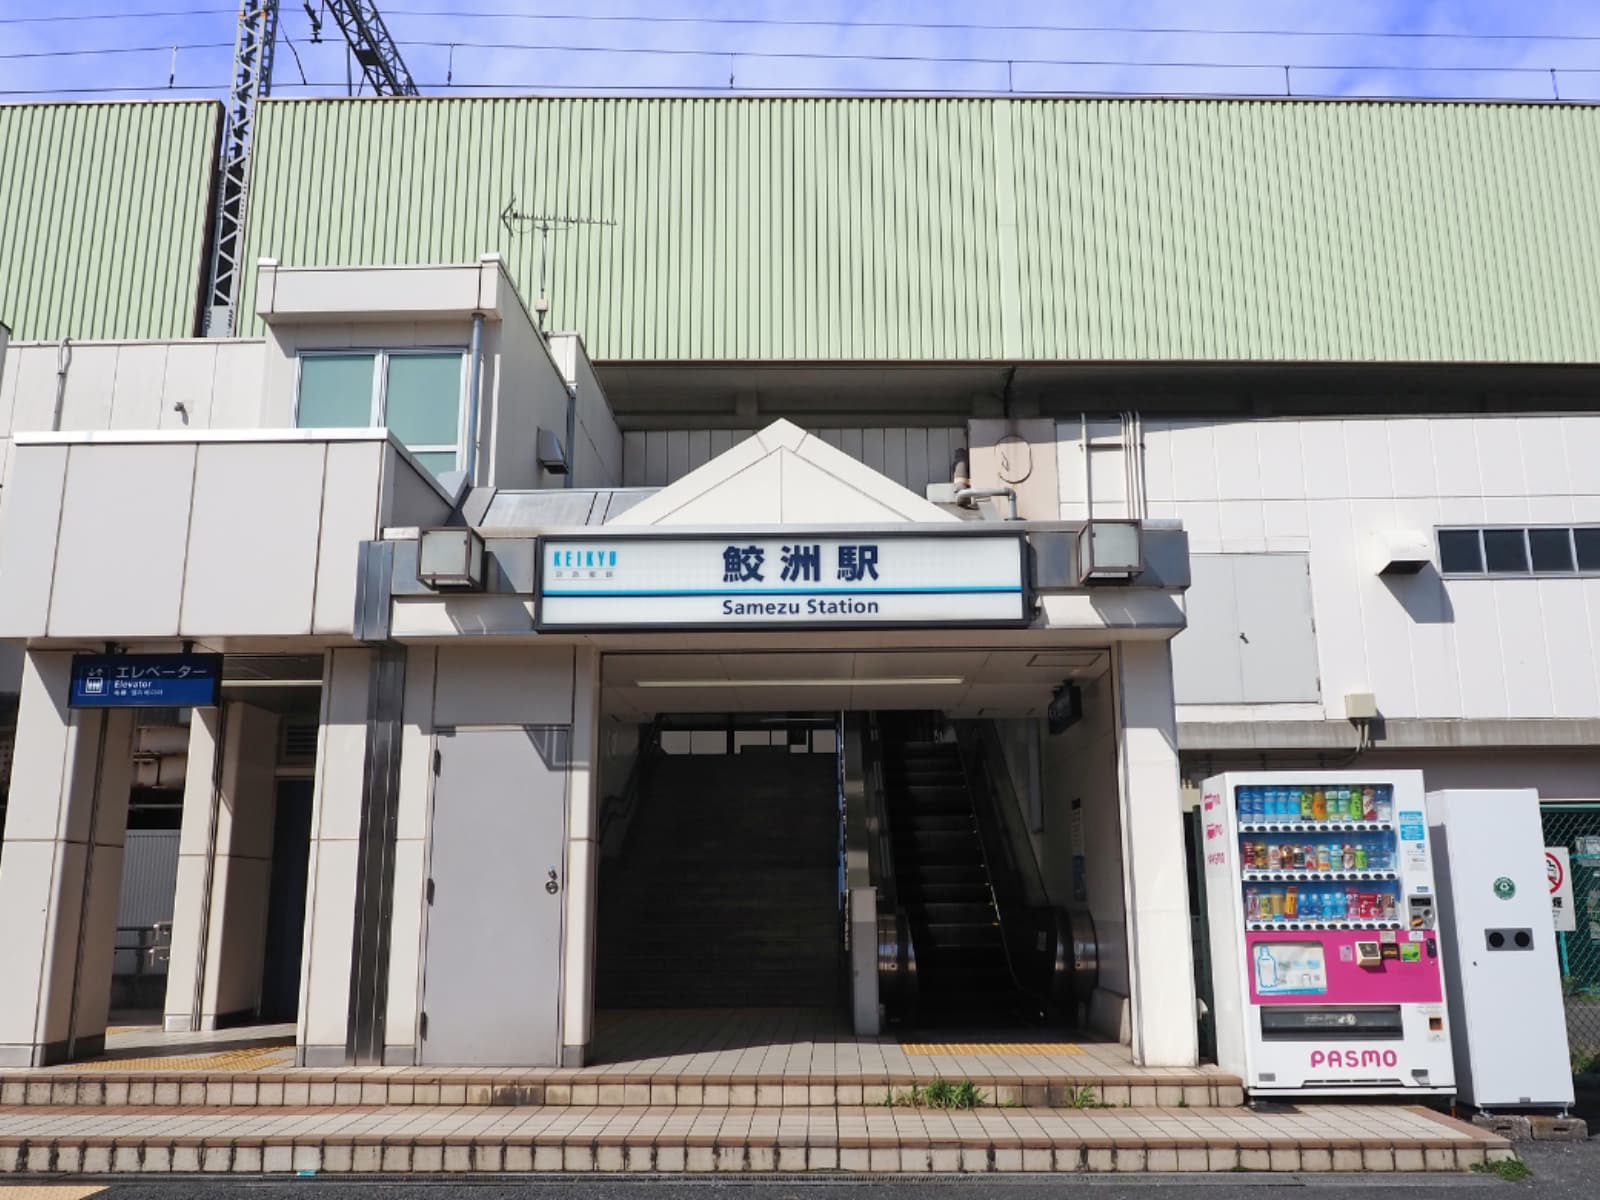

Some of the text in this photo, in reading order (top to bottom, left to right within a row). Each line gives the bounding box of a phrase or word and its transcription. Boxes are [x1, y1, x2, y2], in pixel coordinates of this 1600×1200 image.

[553, 550, 617, 568] KEIKYU
[722, 544, 880, 583] 鮫洲駅
[722, 597, 879, 616] Samezu Station
[115, 664, 208, 679] エレベーター
[113, 679, 153, 689] Elevator
[1310, 1049, 1398, 1069] PASMO
